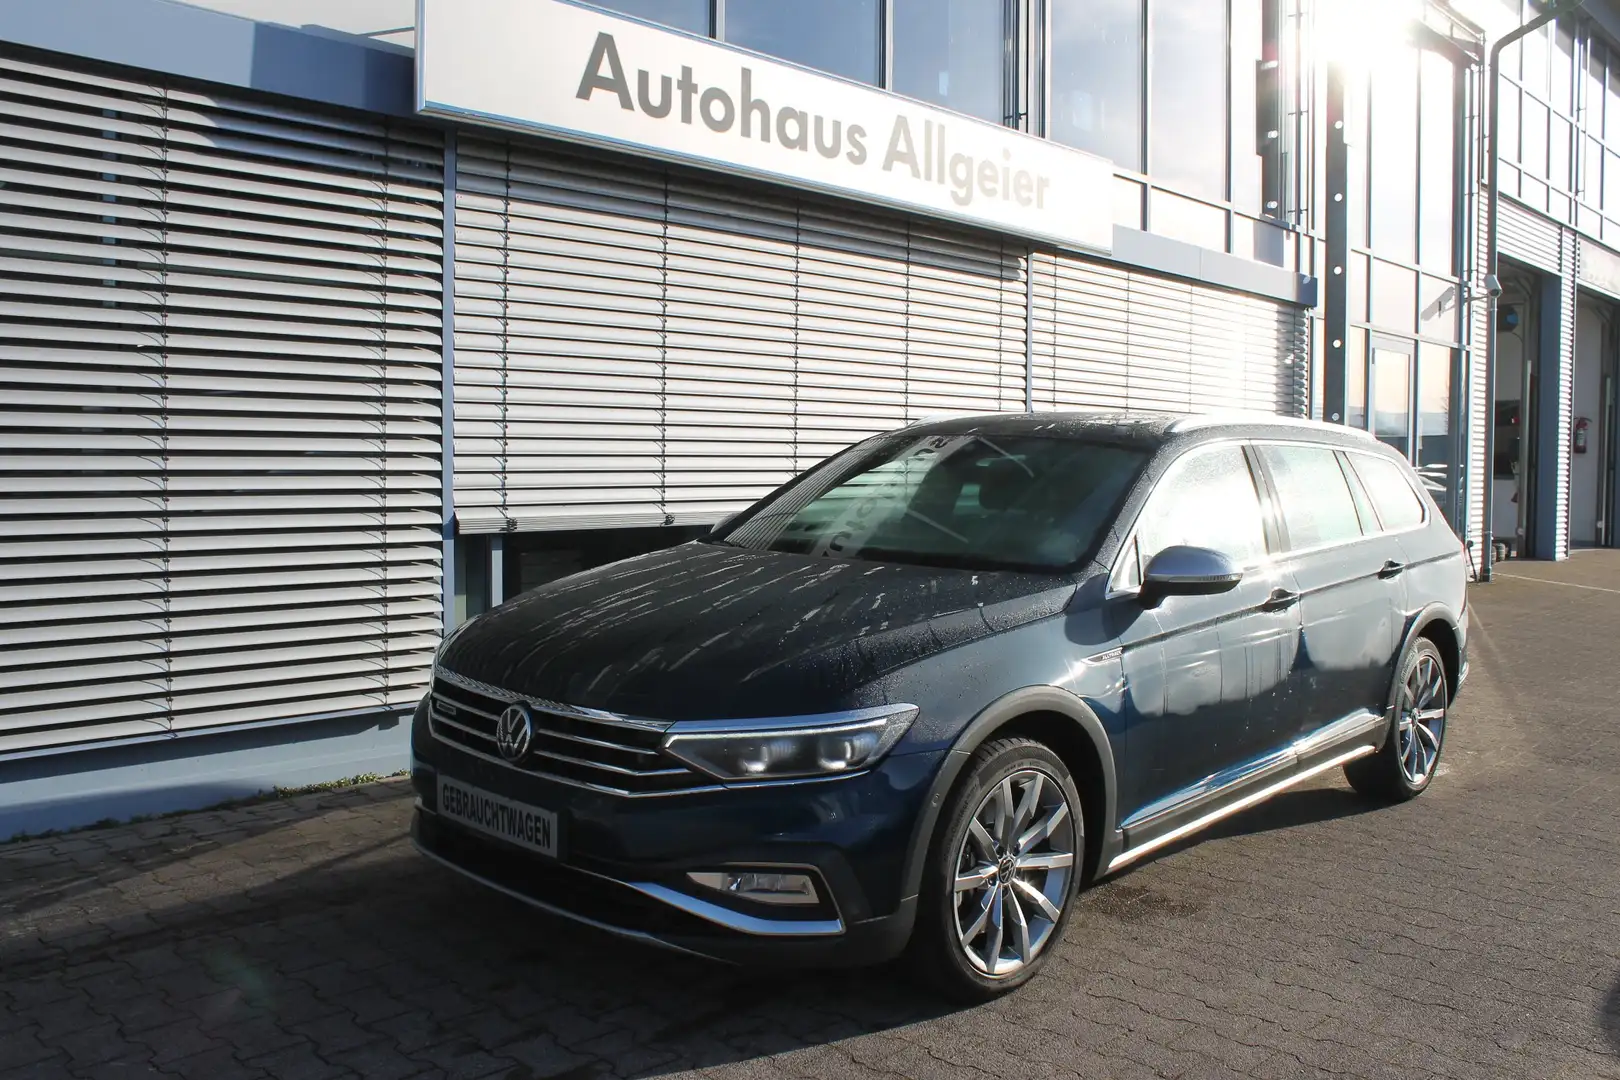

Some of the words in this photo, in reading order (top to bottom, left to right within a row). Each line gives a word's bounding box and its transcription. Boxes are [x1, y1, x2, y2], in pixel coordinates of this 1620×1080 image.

[576, 32, 868, 166] Autohaus
[882, 115, 1050, 210] Allgeier
[442, 783, 551, 849] GEBRAUCHTWAGEN
